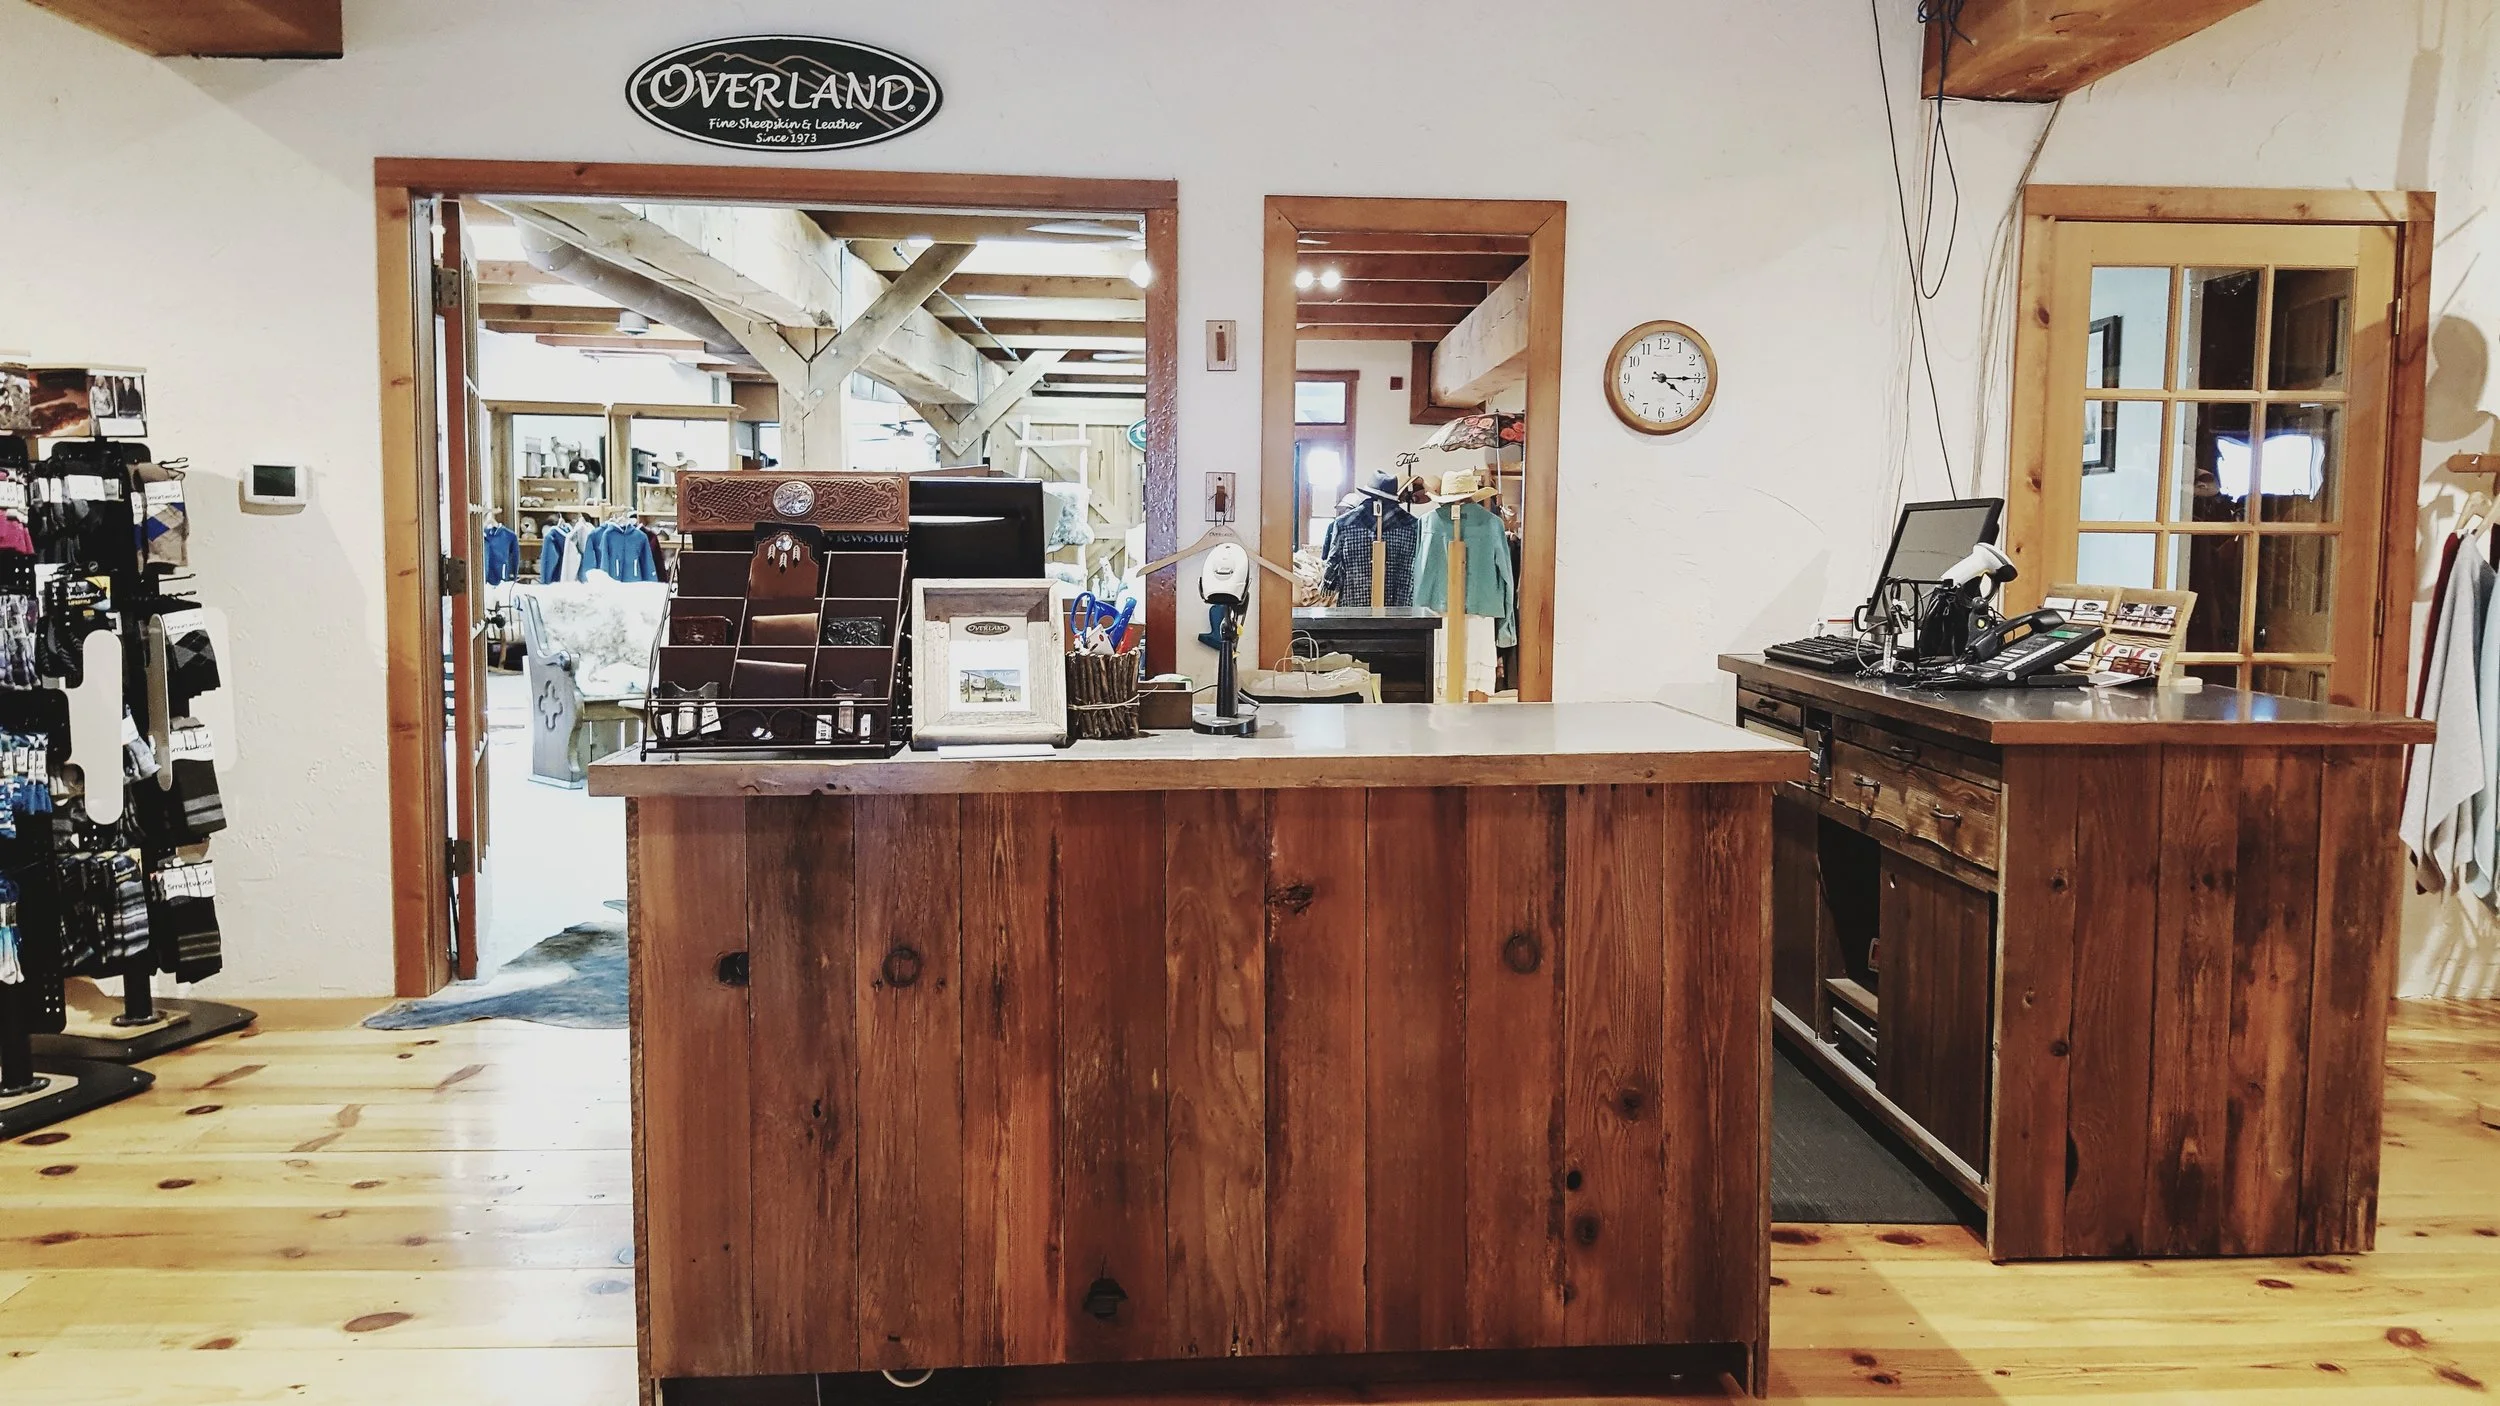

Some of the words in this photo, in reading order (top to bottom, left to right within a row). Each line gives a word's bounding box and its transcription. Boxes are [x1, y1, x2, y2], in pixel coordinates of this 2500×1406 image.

[708, 117, 738, 130] Fine
[738, 117, 802, 133] Sheepskin
[802, 118, 811, 130] &
[815, 118, 863, 130] Leather
[756, 132, 789, 144] Since
[790, 132, 817, 145] 1973
[1642, 343, 1651, 355] 11
[1658, 337, 1671, 350] 12
[1677, 341, 1682, 354] 1
[1629, 355, 1640, 368] 10
[1688, 354, 1696, 366] 2
[1623, 373, 1631, 384] 9
[1693, 372, 1701, 384] 3
[1628, 391, 1635, 402] 8
[1687, 389, 1695, 401] 4
[1642, 402, 1649, 415] 7
[1657, 407, 1665, 418] 6
[1675, 402, 1682, 414] 5
